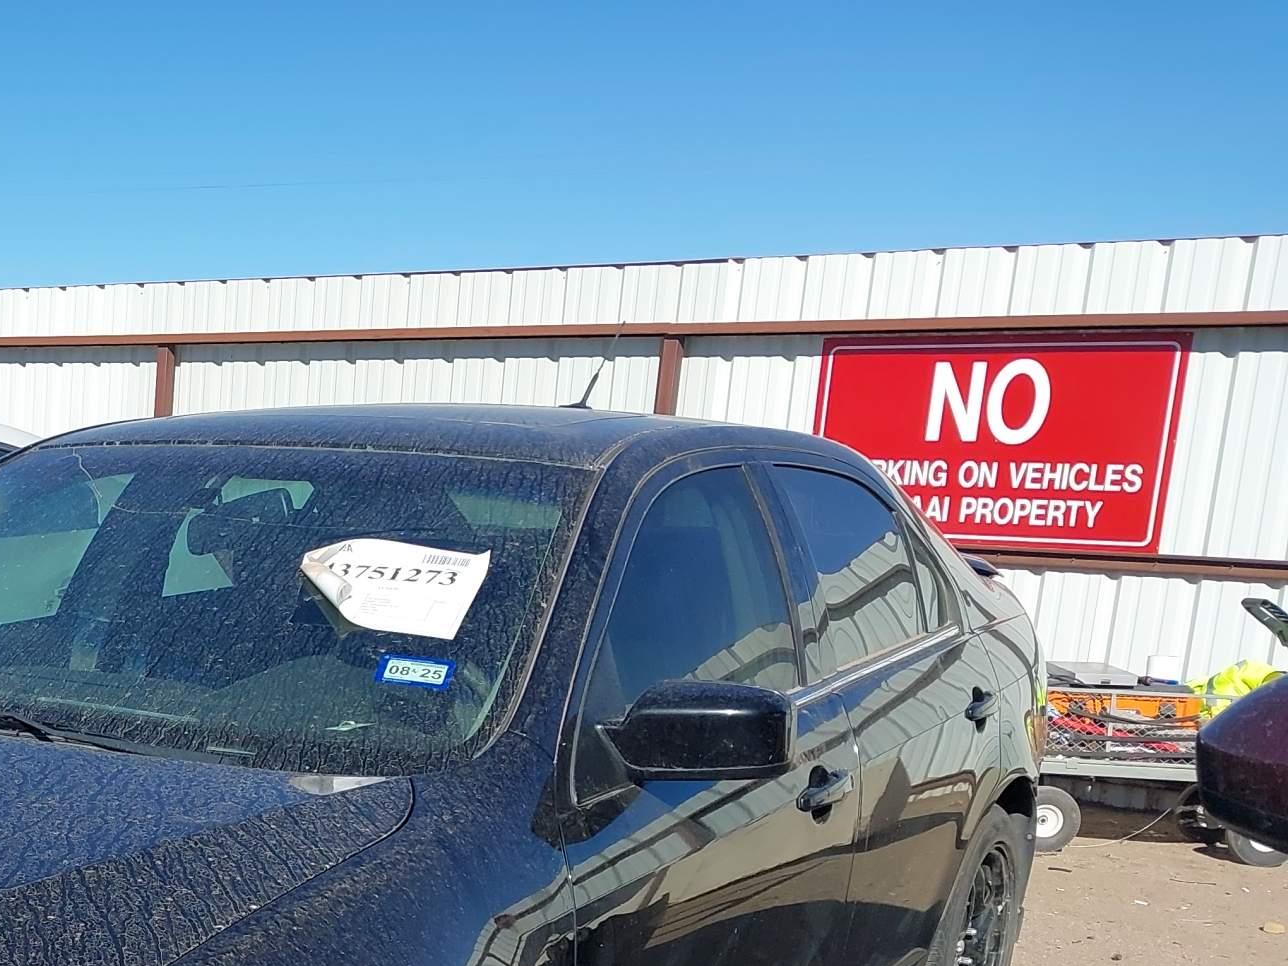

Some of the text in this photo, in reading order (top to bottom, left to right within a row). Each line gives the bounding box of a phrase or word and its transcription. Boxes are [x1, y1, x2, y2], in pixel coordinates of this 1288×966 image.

[924, 357, 1052, 445] NO
[958, 460, 999, 489] ON
[1009, 462, 1144, 493] VEHICLES
[959, 498, 1104, 528] PROPERTY
[328, 562, 459, 586] 3751273
[388, 665, 443, 680] 08 25
